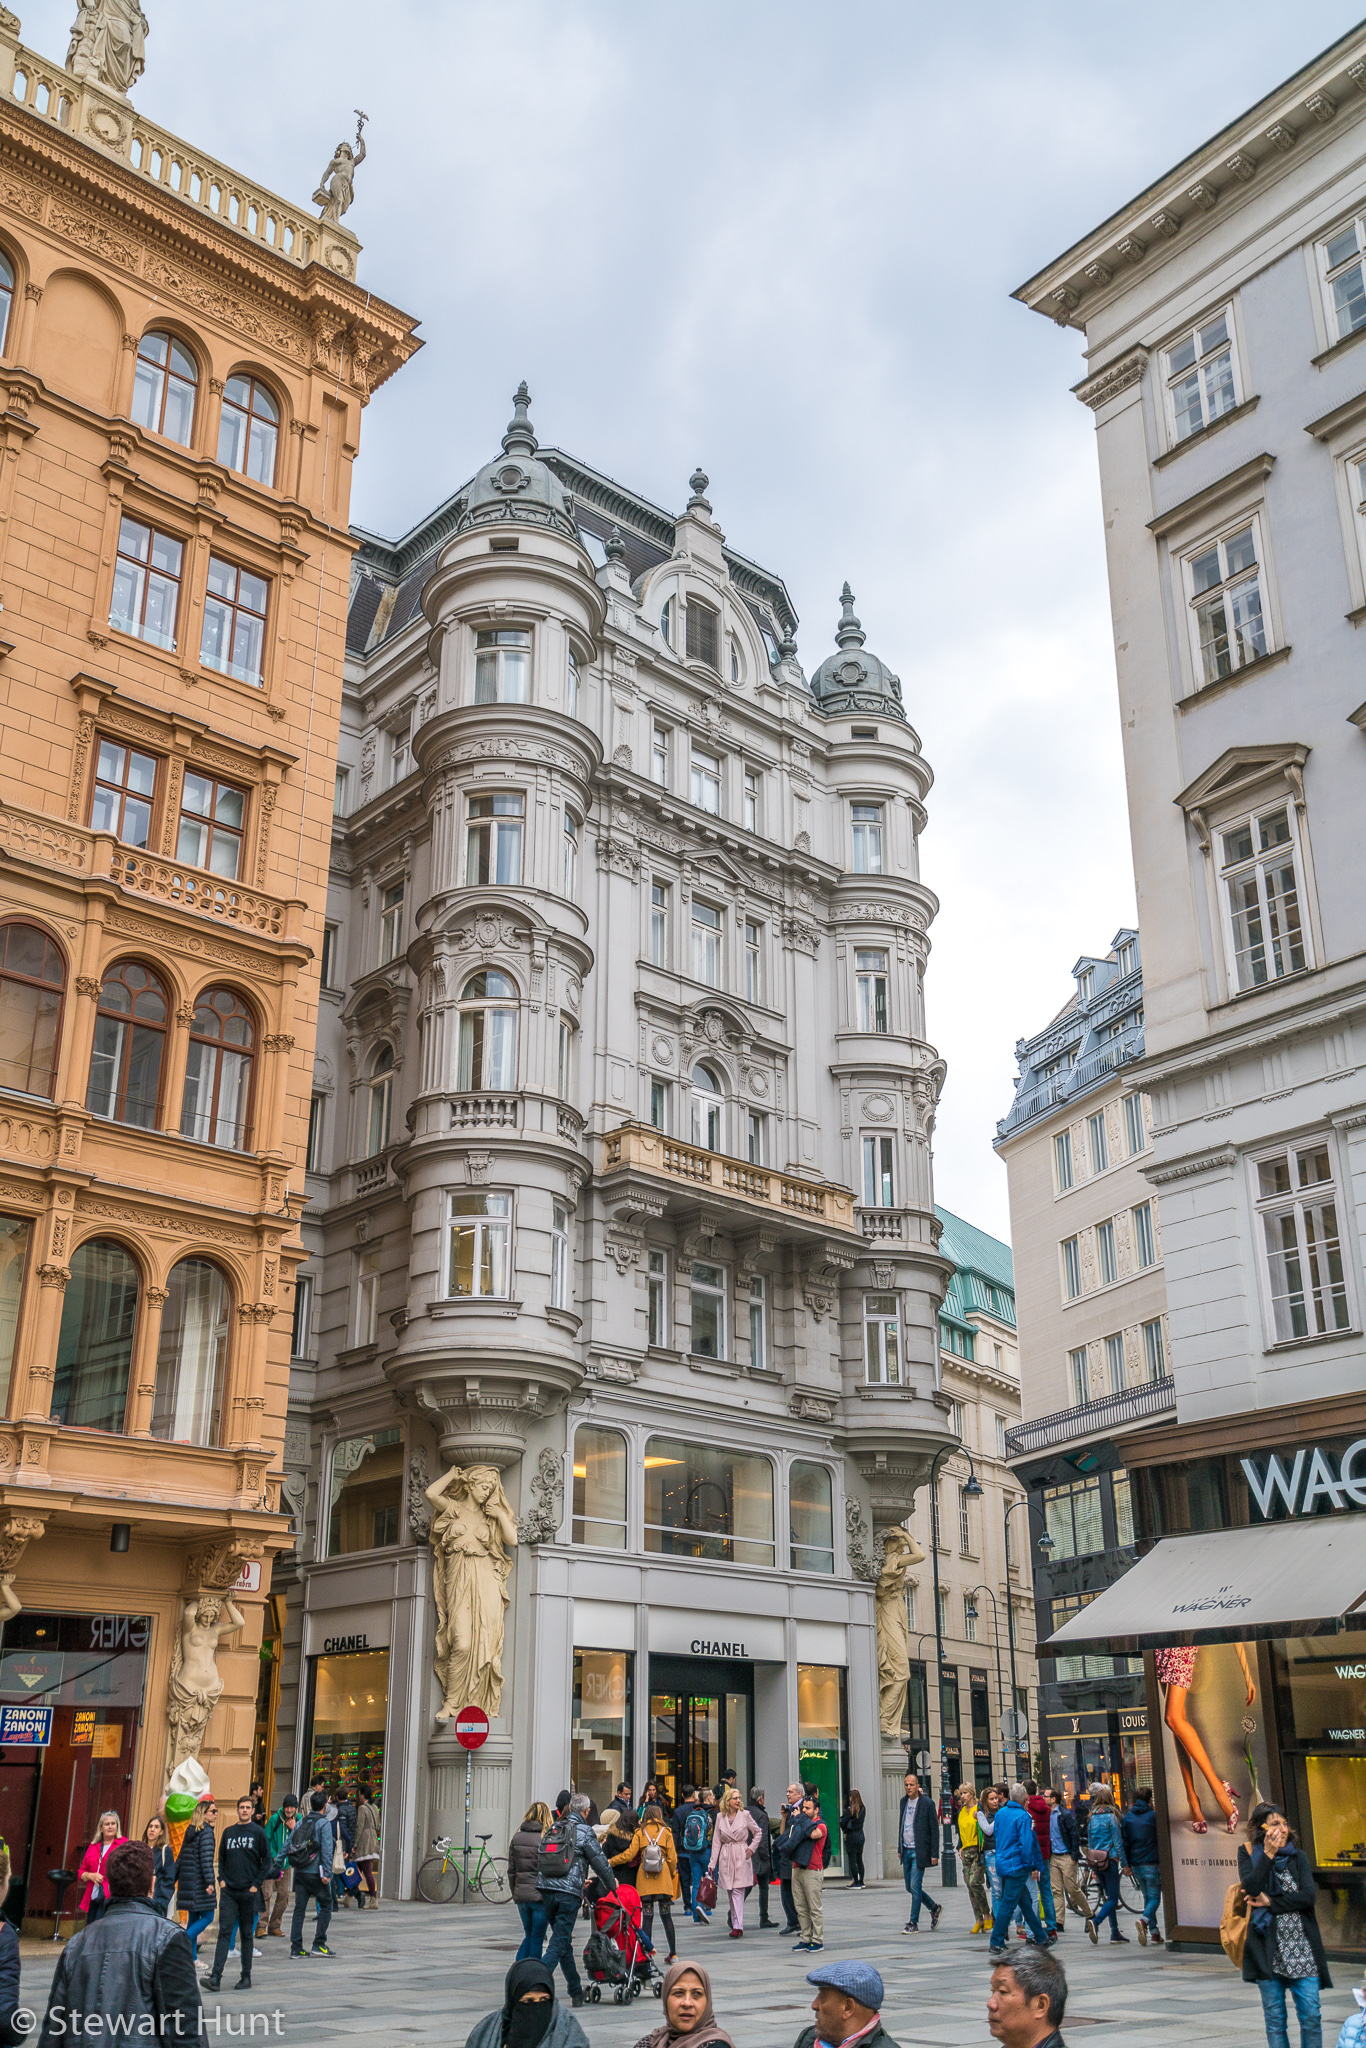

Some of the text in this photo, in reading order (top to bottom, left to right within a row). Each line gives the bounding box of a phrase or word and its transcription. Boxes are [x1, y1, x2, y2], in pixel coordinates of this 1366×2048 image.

[1172, 1597, 1252, 1614] WAGNER
[324, 1634, 370, 1652] CHANEL
[691, 1639, 749, 1657] CHANEL
[5, 1709, 47, 1720] ZANONI
[75, 1711, 96, 1722] ZANONI
[3, 1721, 46, 1732] ZANONI
[1121, 1714, 1146, 1728] LOUIS
[1328, 1729, 1366, 1740] WAGNER
[1181, 1858, 1198, 1866] HOME
